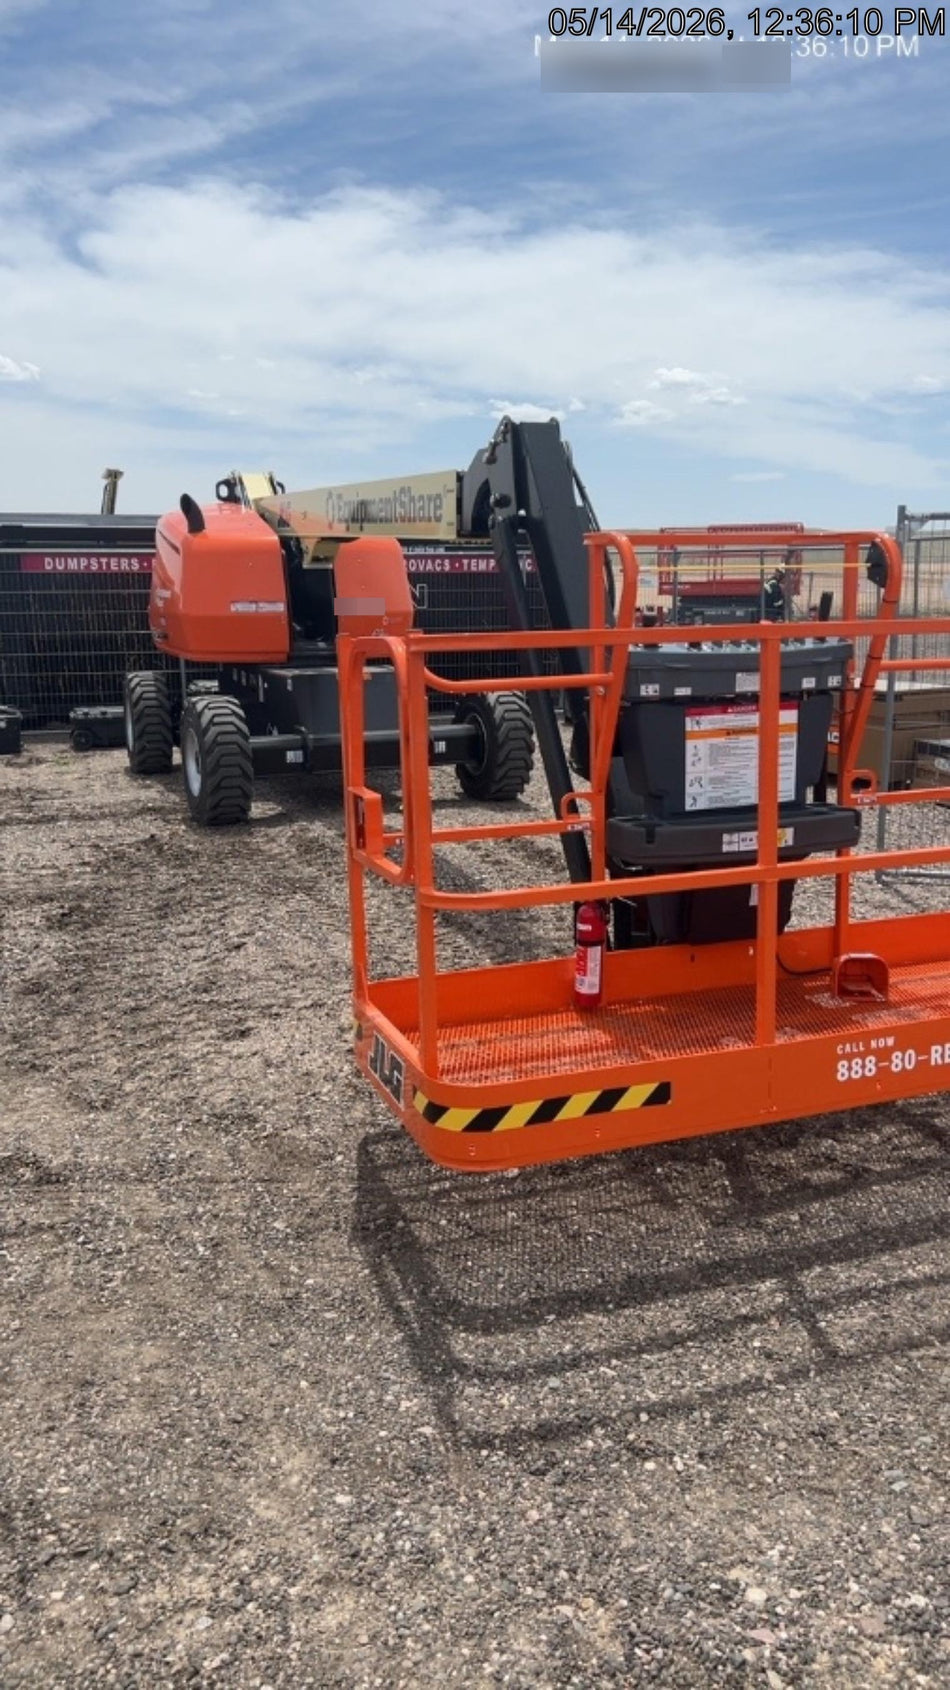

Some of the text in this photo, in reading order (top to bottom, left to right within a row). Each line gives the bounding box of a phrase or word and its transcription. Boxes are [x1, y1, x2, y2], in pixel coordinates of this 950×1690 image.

[336, 485, 443, 532] EquipmentShare
[44, 556, 139, 571] DUMPSTERS
[837, 1036, 895, 1054] CALL NOW
[367, 1031, 405, 1111] JLG
